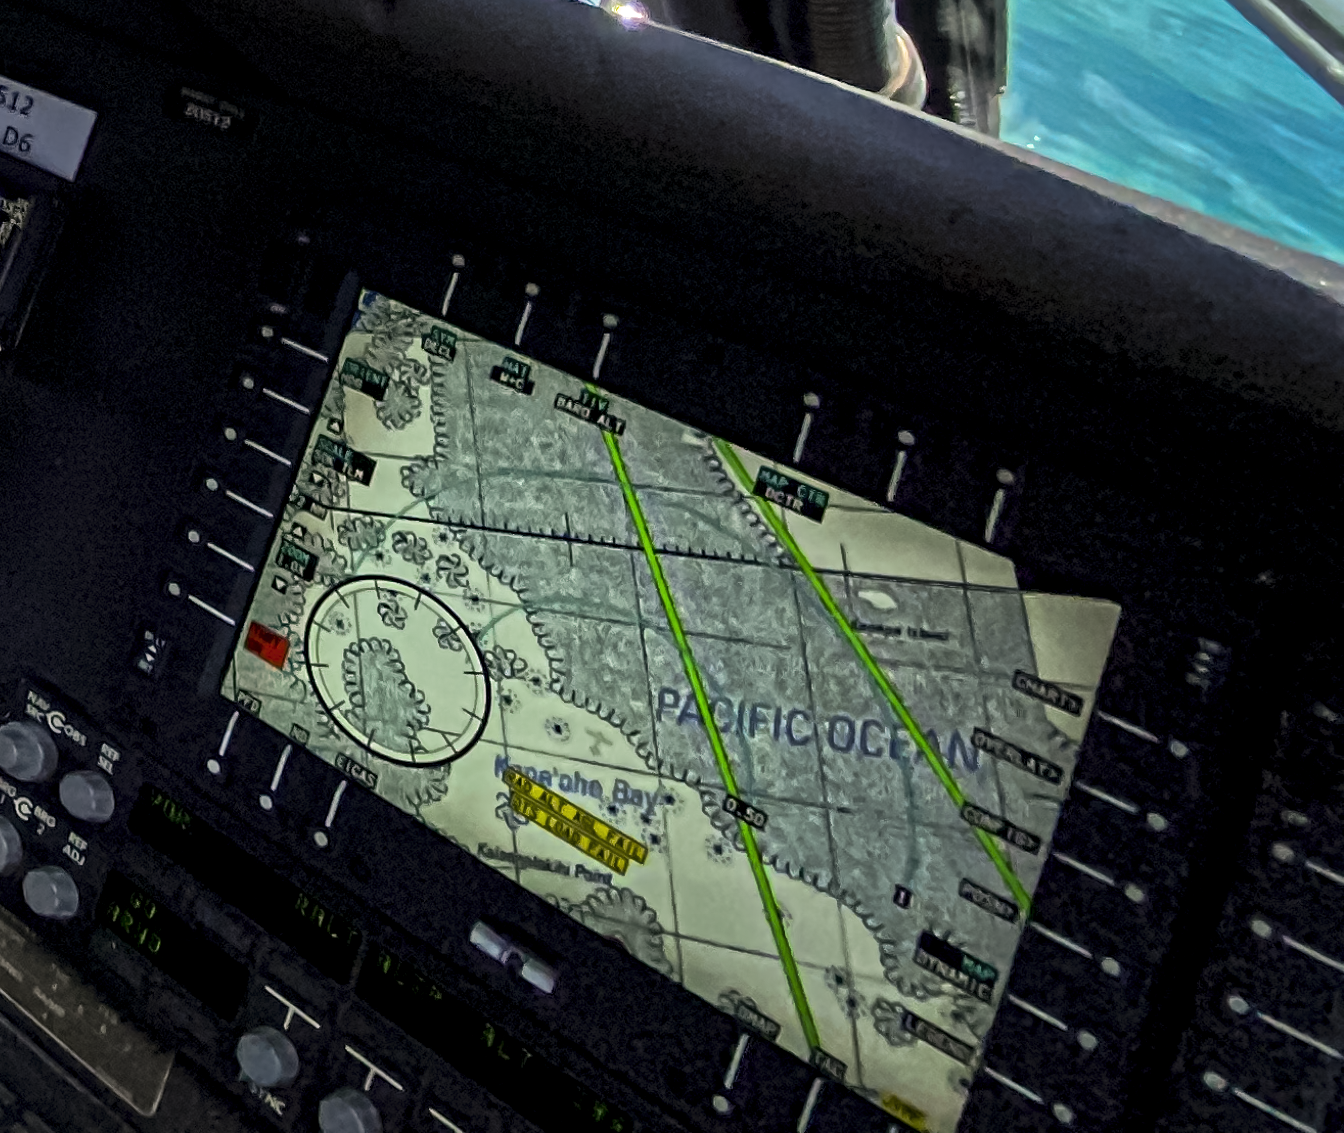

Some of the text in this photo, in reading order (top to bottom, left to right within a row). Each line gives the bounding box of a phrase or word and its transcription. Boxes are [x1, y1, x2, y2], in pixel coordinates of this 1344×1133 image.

[2, 125, 34, 154] D6
[27, 689, 51, 711] NAV
[656, 688, 812, 747] PACIFIC
[63, 724, 88, 747] OBS
[827, 715, 981, 772] OCEAN
[613, 777, 661, 817] Bay
[726, 796, 766, 829] 0.50
[63, 844, 86, 866] ADJ
[589, 843, 627, 874] FAIL
[607, 830, 647, 863] FAIL
